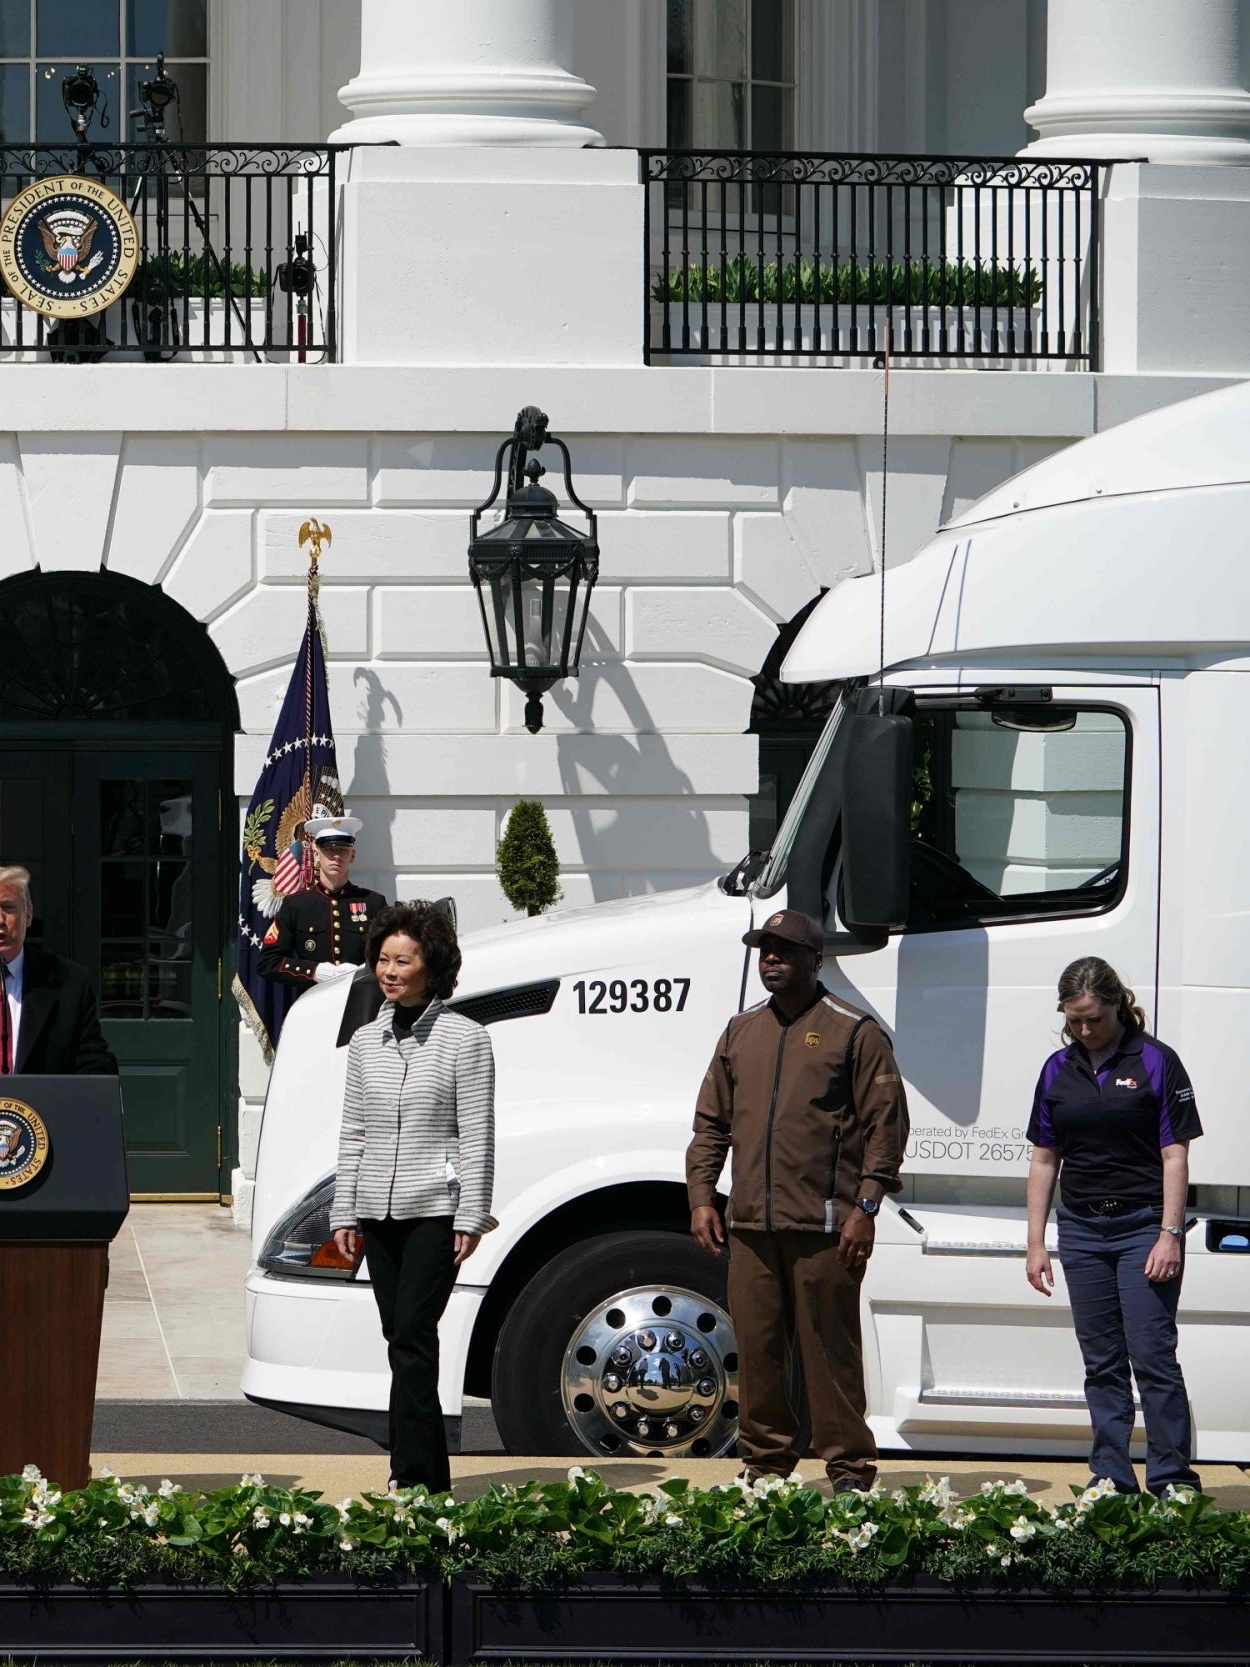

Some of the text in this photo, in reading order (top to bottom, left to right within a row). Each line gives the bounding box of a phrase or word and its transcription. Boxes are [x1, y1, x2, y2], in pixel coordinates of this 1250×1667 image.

[1, 180, 135, 312] SEAL OF THE PRESIDENT OF THE UNITED STATES
[572, 978, 691, 1014] 129387
[15, 1104, 25, 1114] THE
[27, 1113, 45, 1150] UNITED
[909, 1126, 1026, 1140] perated by FedEx Gr
[904, 1140, 975, 1160] USDOT
[10, 1159, 42, 1186] STATES
